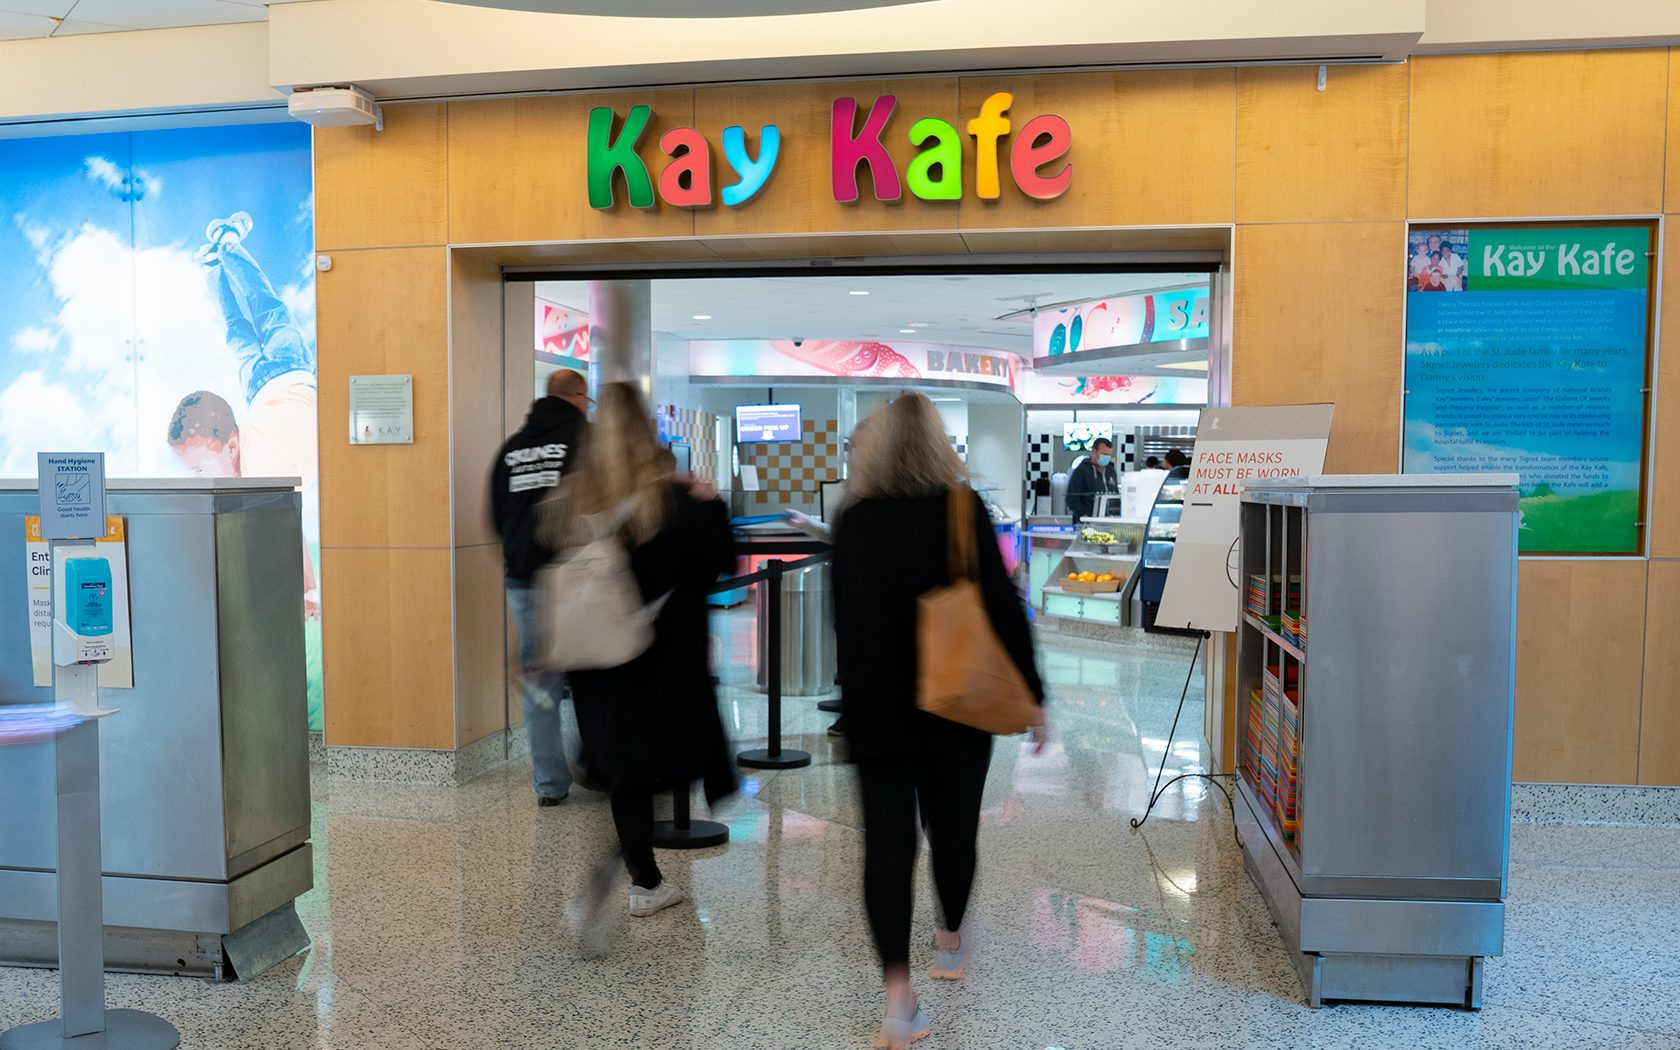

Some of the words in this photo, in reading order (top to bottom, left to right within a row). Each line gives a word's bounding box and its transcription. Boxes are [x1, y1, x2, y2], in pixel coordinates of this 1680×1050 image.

[587, 105, 781, 210] Kay
[831, 92, 1074, 204] Kafe
[1483, 244, 1546, 276] Kay
[1558, 242, 1635, 276] Kafe
[926, 350, 1010, 378] BAKERY
[1421, 360, 1448, 370] Signet
[1452, 360, 1490, 369] Jewelers
[1492, 360, 1536, 369] dedicates
[1539, 360, 1555, 368] the
[1557, 360, 1573, 369] Kay
[1575, 360, 1595, 368] Kafe
[1598, 360, 1608, 368] to
[1420, 373, 1455, 383] Danny's
[1458, 373, 1486, 381] vision.
[379, 426, 400, 434] KAY
[1199, 452, 1234, 464] FACE
[1237, 452, 1282, 464] MASKS
[1196, 468, 1234, 479] MUST
[1193, 484, 1210, 495] AT
[1213, 484, 1238, 495] ALL
